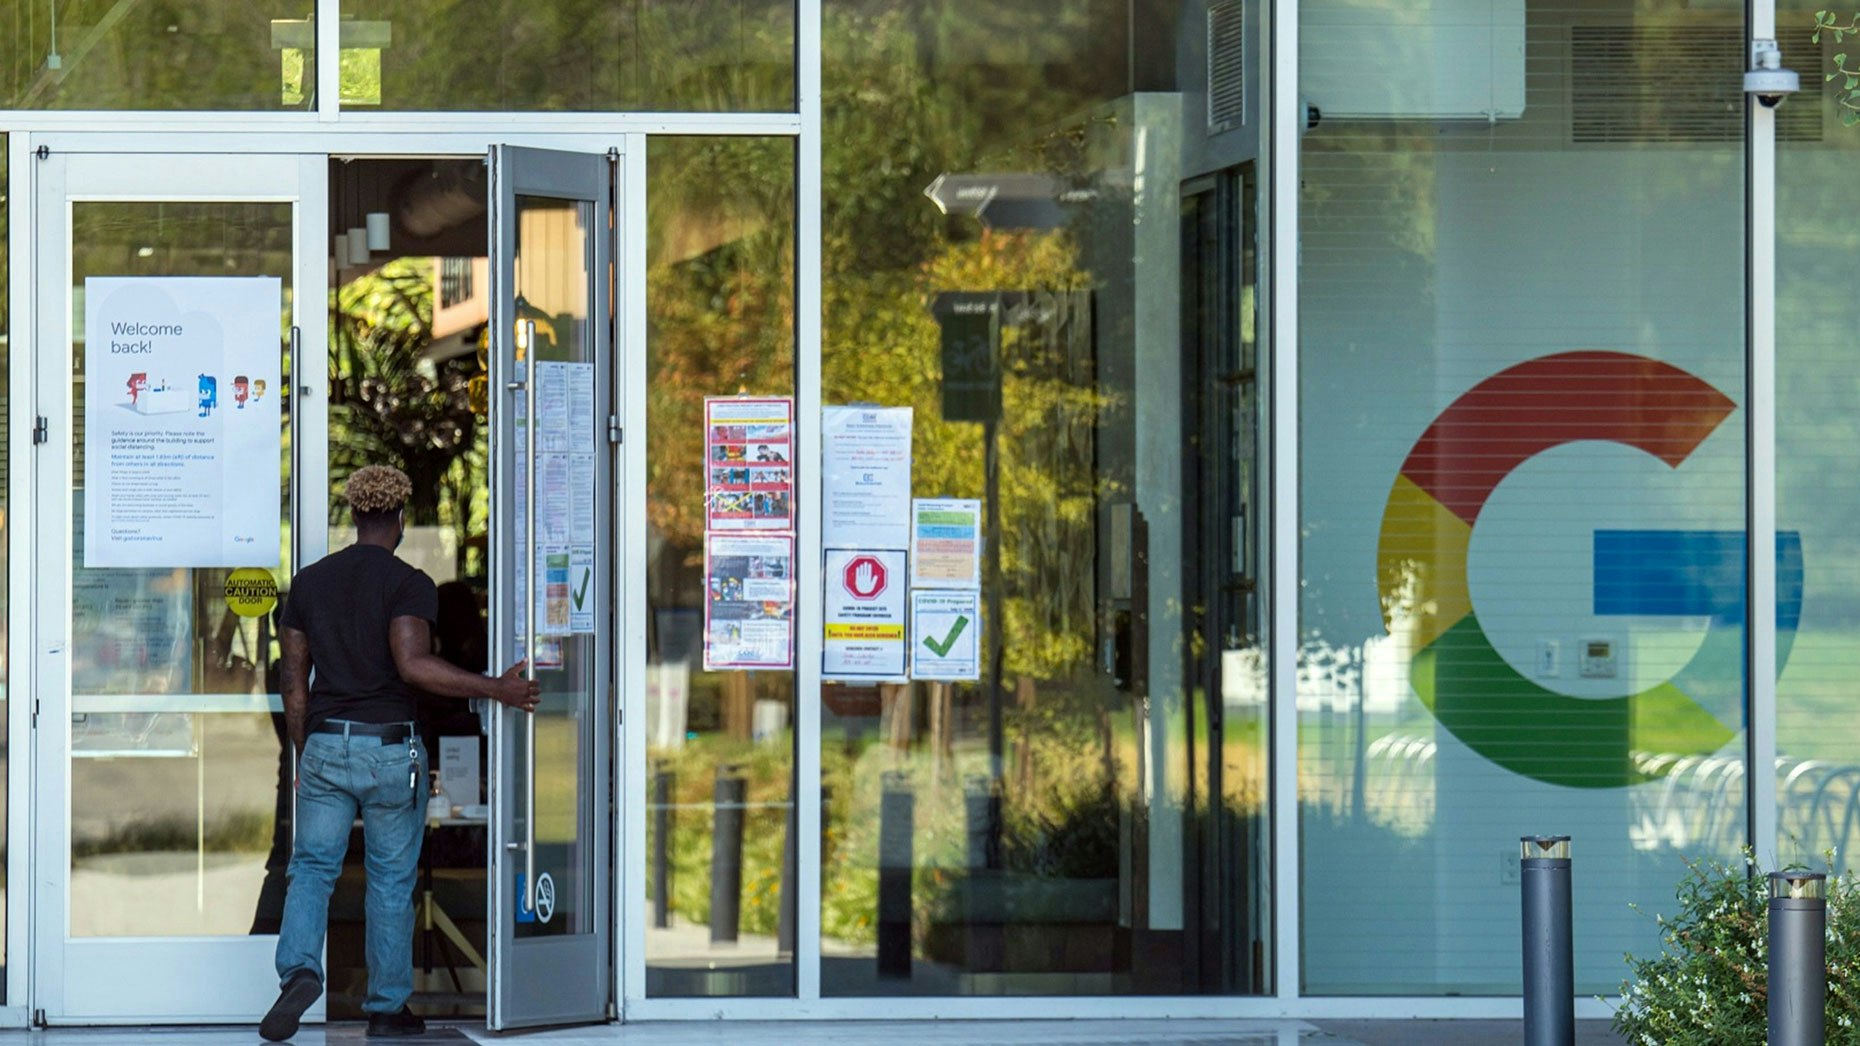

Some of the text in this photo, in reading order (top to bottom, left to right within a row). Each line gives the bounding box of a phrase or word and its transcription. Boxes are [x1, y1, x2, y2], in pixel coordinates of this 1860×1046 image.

[111, 322, 183, 336] Welcome
[111, 340, 152, 354] back!
[1376, 350, 1804, 788] G
[227, 579, 274, 587] AUTOMATIC
[225, 587, 276, 596] CAUTION
